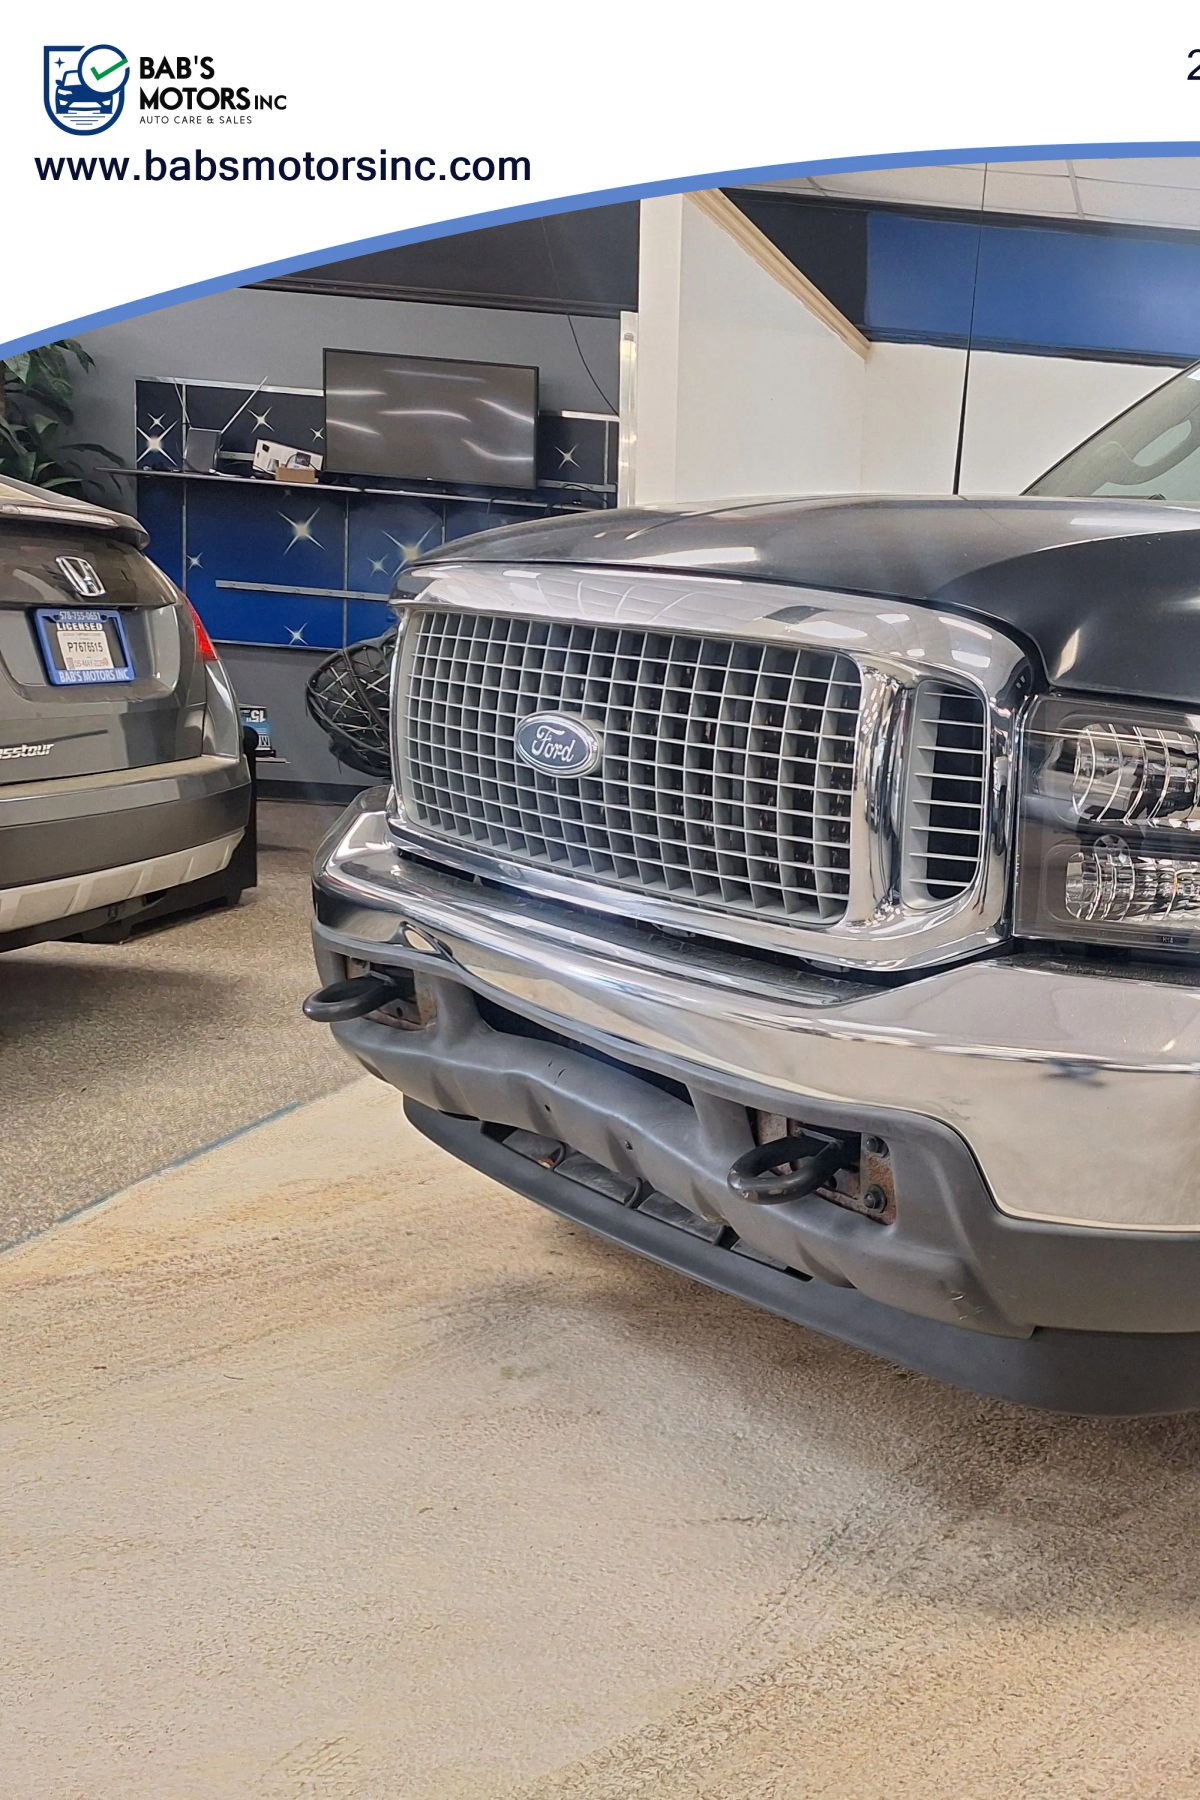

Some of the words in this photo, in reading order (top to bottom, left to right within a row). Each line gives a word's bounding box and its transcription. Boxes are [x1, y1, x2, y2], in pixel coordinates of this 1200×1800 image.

[56, 622, 103, 631] LICENSED
[83, 670, 115, 682] MOTORS
[115, 669, 130, 680] INC
[531, 725, 576, 763] Ford
